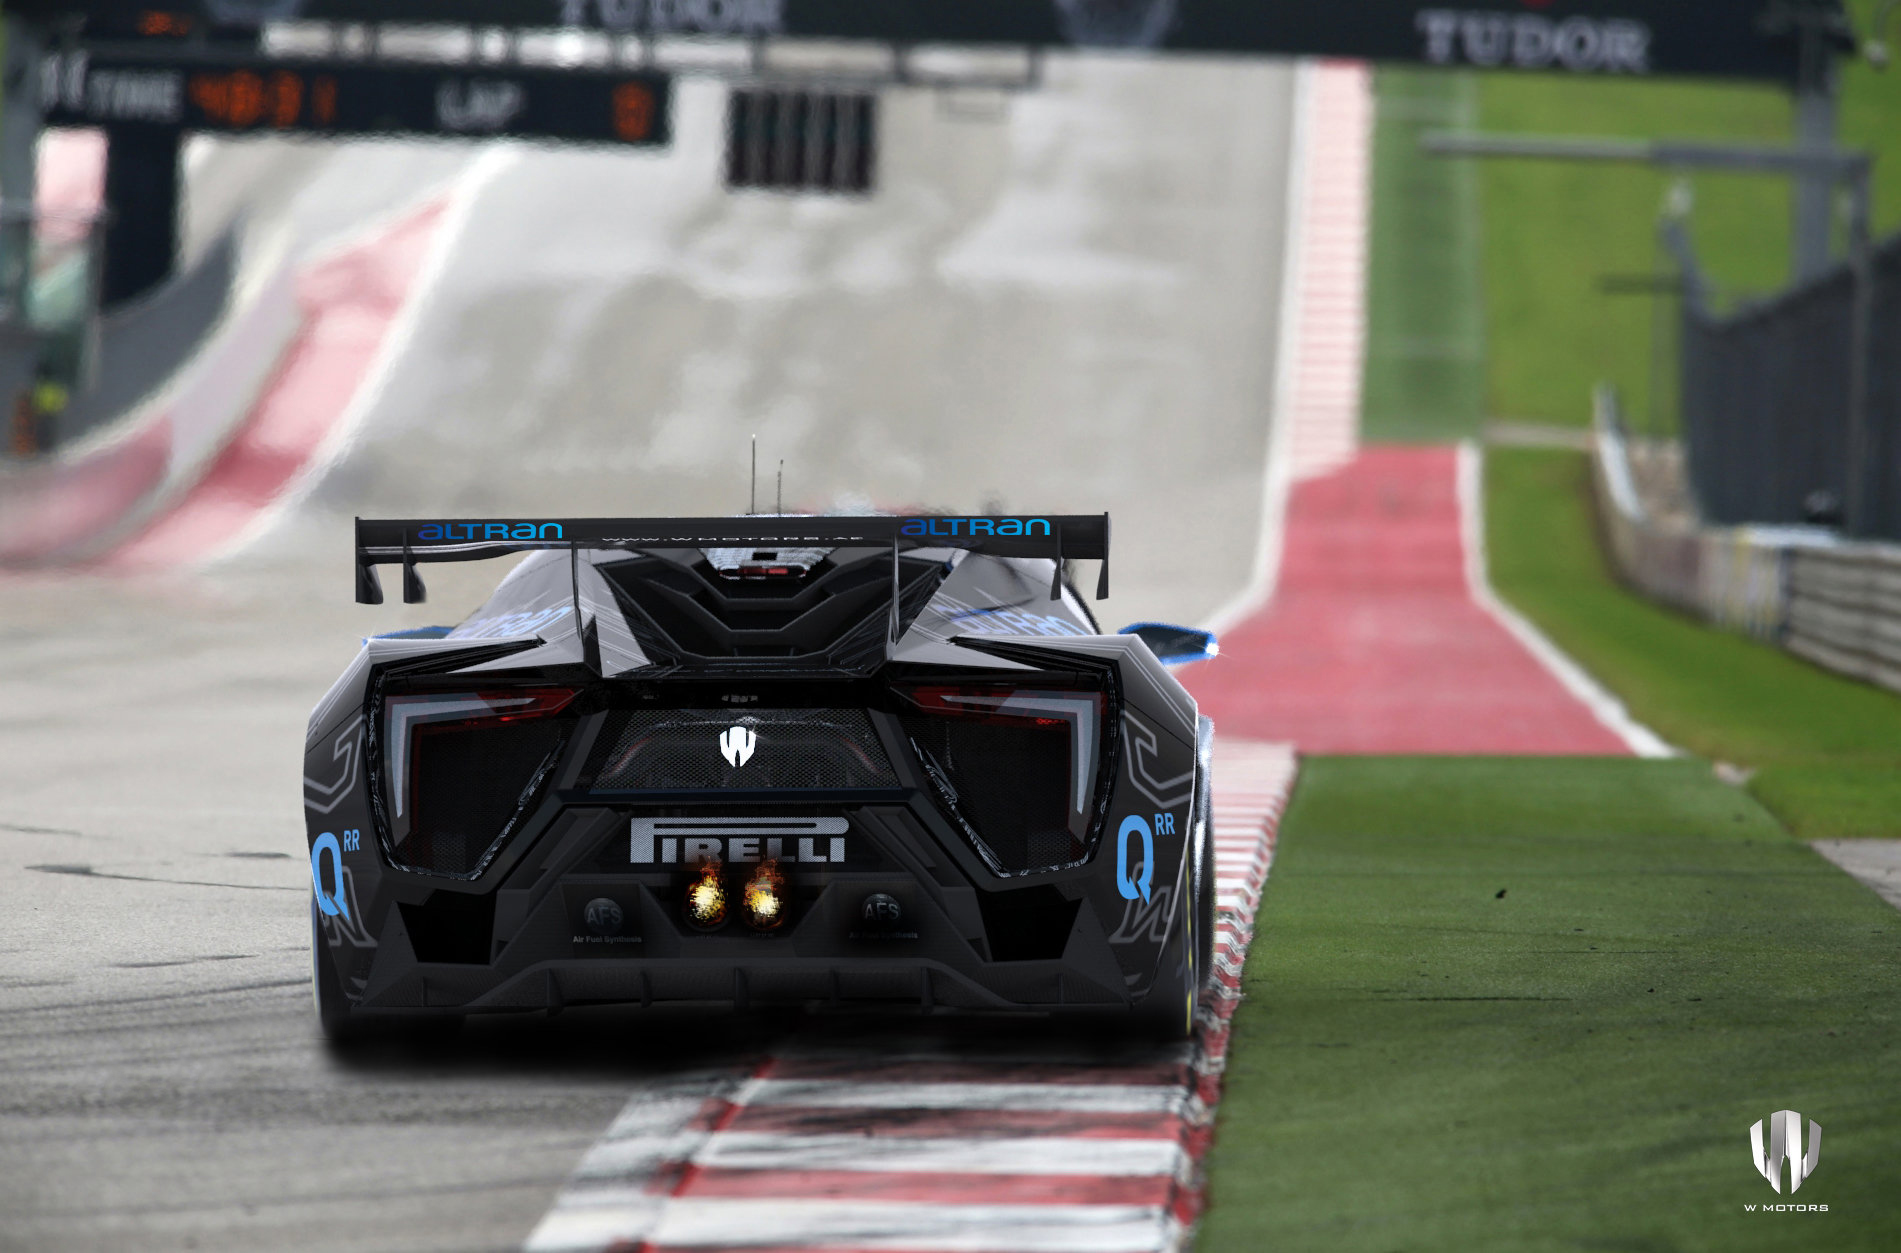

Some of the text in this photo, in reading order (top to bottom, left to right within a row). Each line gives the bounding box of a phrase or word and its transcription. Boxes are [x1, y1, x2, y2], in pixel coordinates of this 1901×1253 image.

[1416, 8, 1651, 73] TUDOR
[343, 829, 360, 852] RR
[630, 817, 850, 864] PIRELLI
[1154, 812, 1176, 836] RR
[311, 832, 350, 920] Q
[1116, 814, 1154, 906] Q
[586, 906, 622, 926] AFS
[863, 902, 900, 921] AFS
